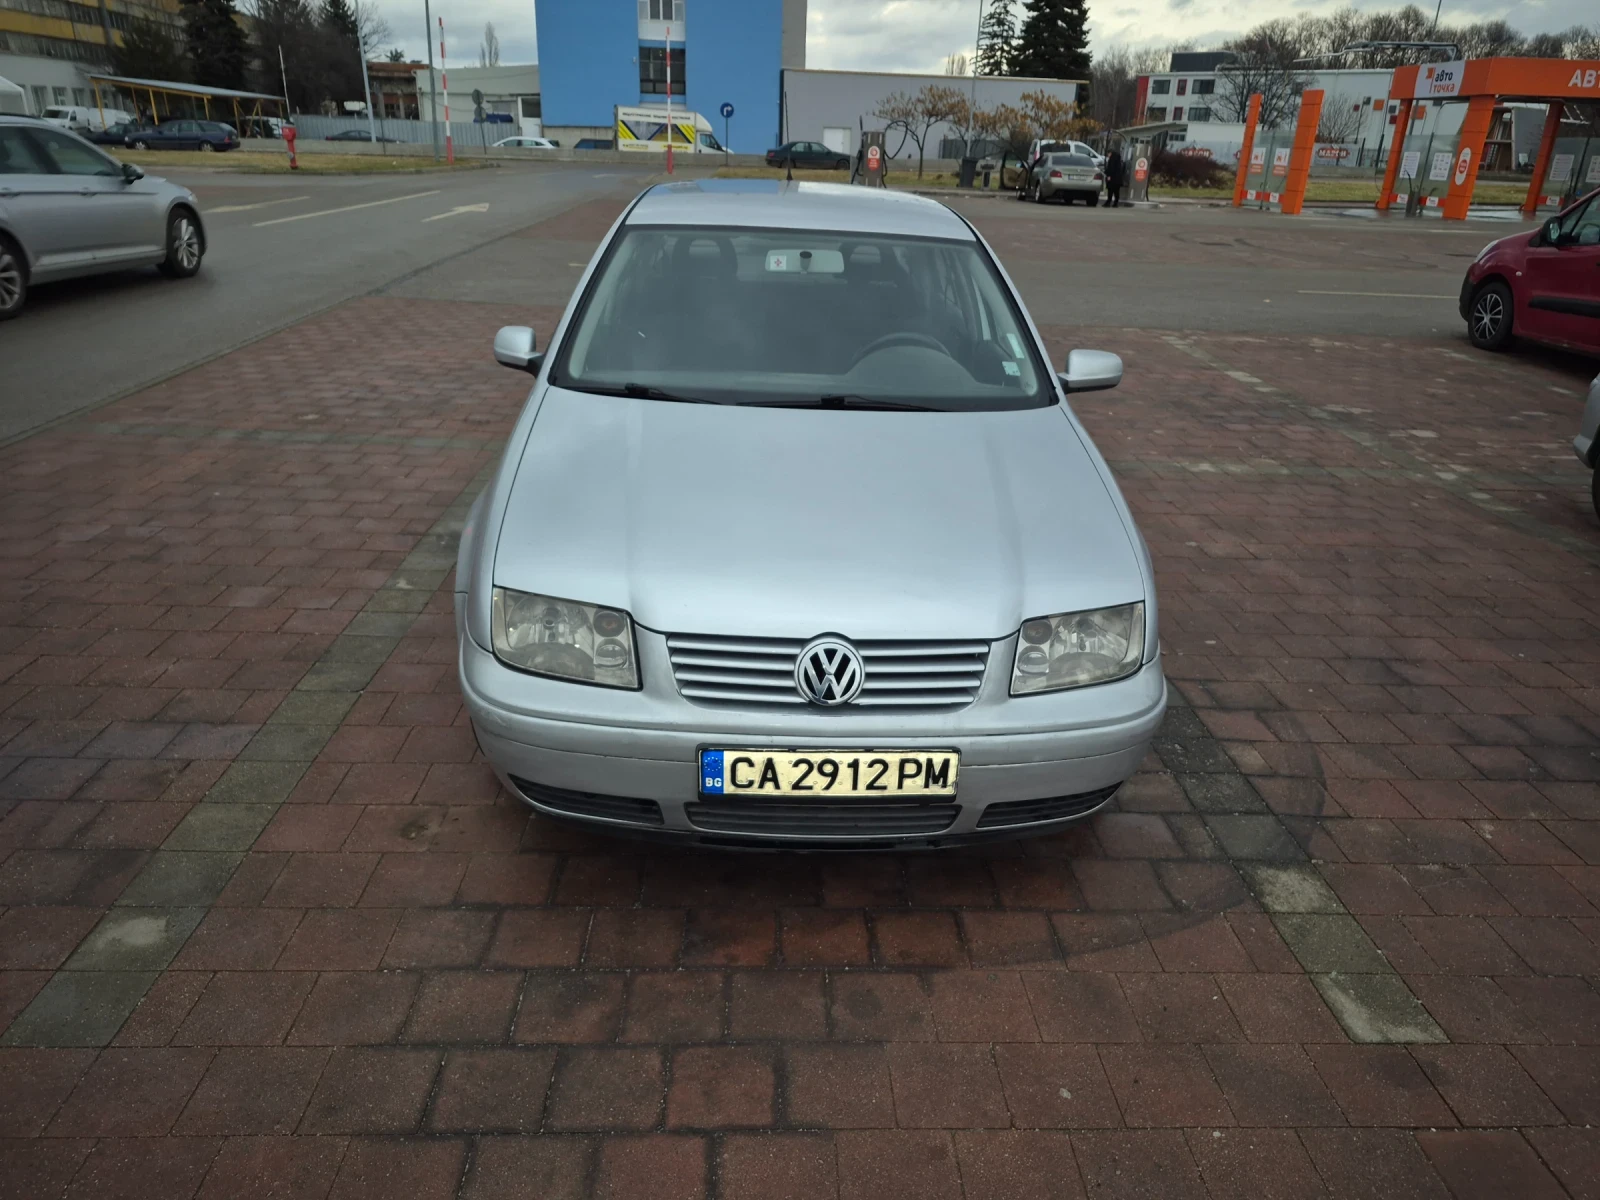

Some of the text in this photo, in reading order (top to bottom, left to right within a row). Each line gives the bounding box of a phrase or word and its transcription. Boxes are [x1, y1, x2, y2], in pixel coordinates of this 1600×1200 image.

[1567, 69, 1600, 88] АВ
[1433, 83, 1456, 94] точка
[705, 777, 722, 787] BG
